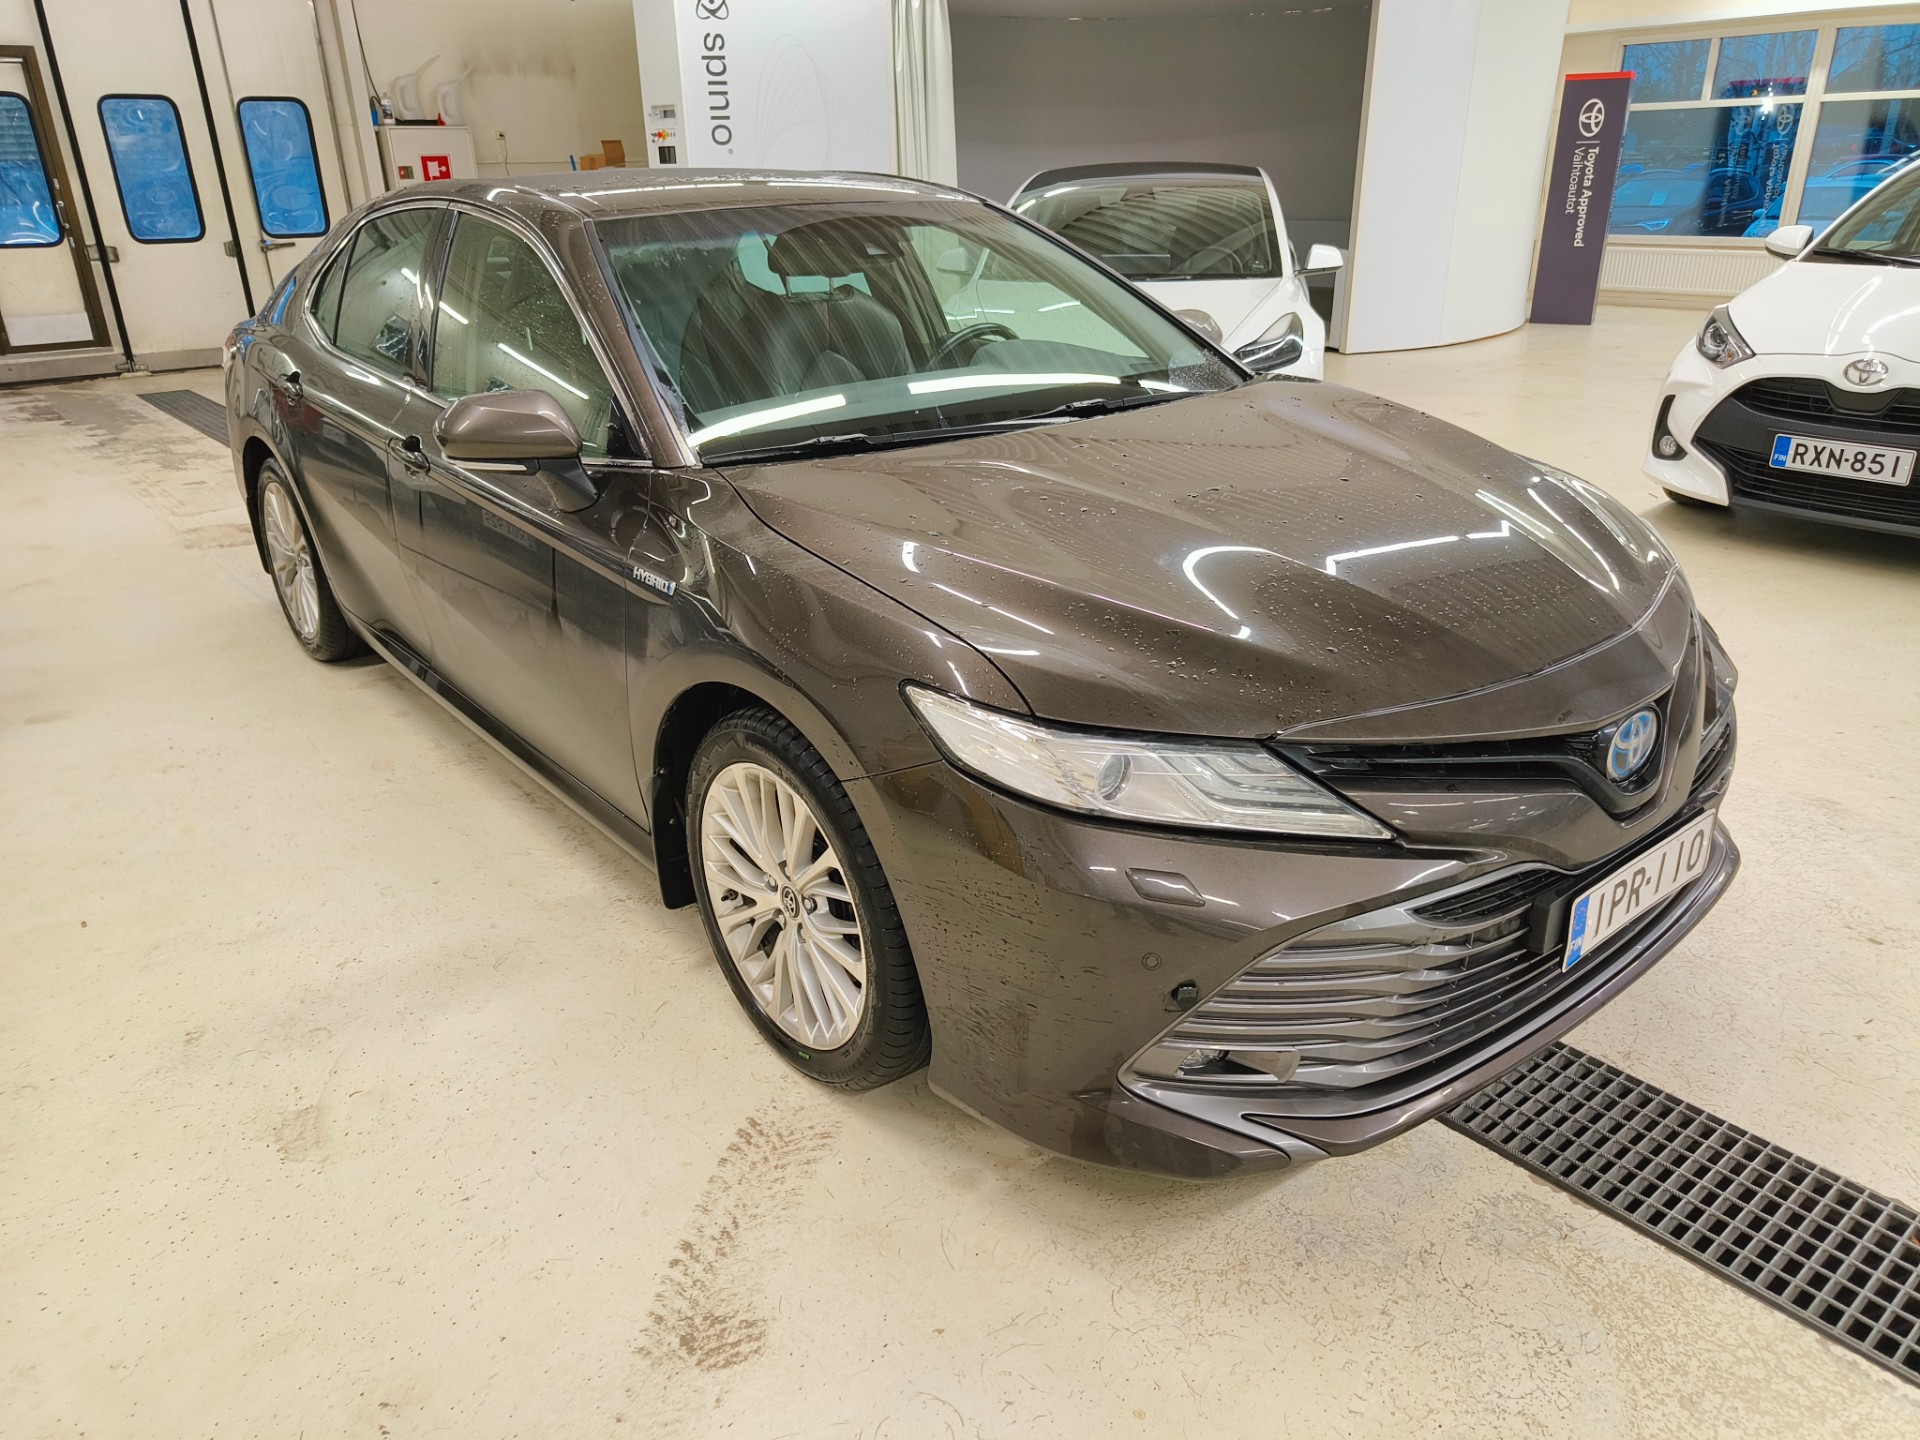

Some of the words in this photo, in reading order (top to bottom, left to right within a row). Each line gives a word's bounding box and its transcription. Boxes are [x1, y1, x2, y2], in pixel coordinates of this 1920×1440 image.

[1565, 147, 1586, 214] Vaihtoautot
[1583, 147, 1600, 187] Toyota
[1573, 189, 1593, 247] Approved
[1773, 454, 1787, 462] FIN
[1791, 443, 1900, 478] RXN-851
[633, 566, 669, 593] HYBRID
[1571, 936, 1583, 951] FIN
